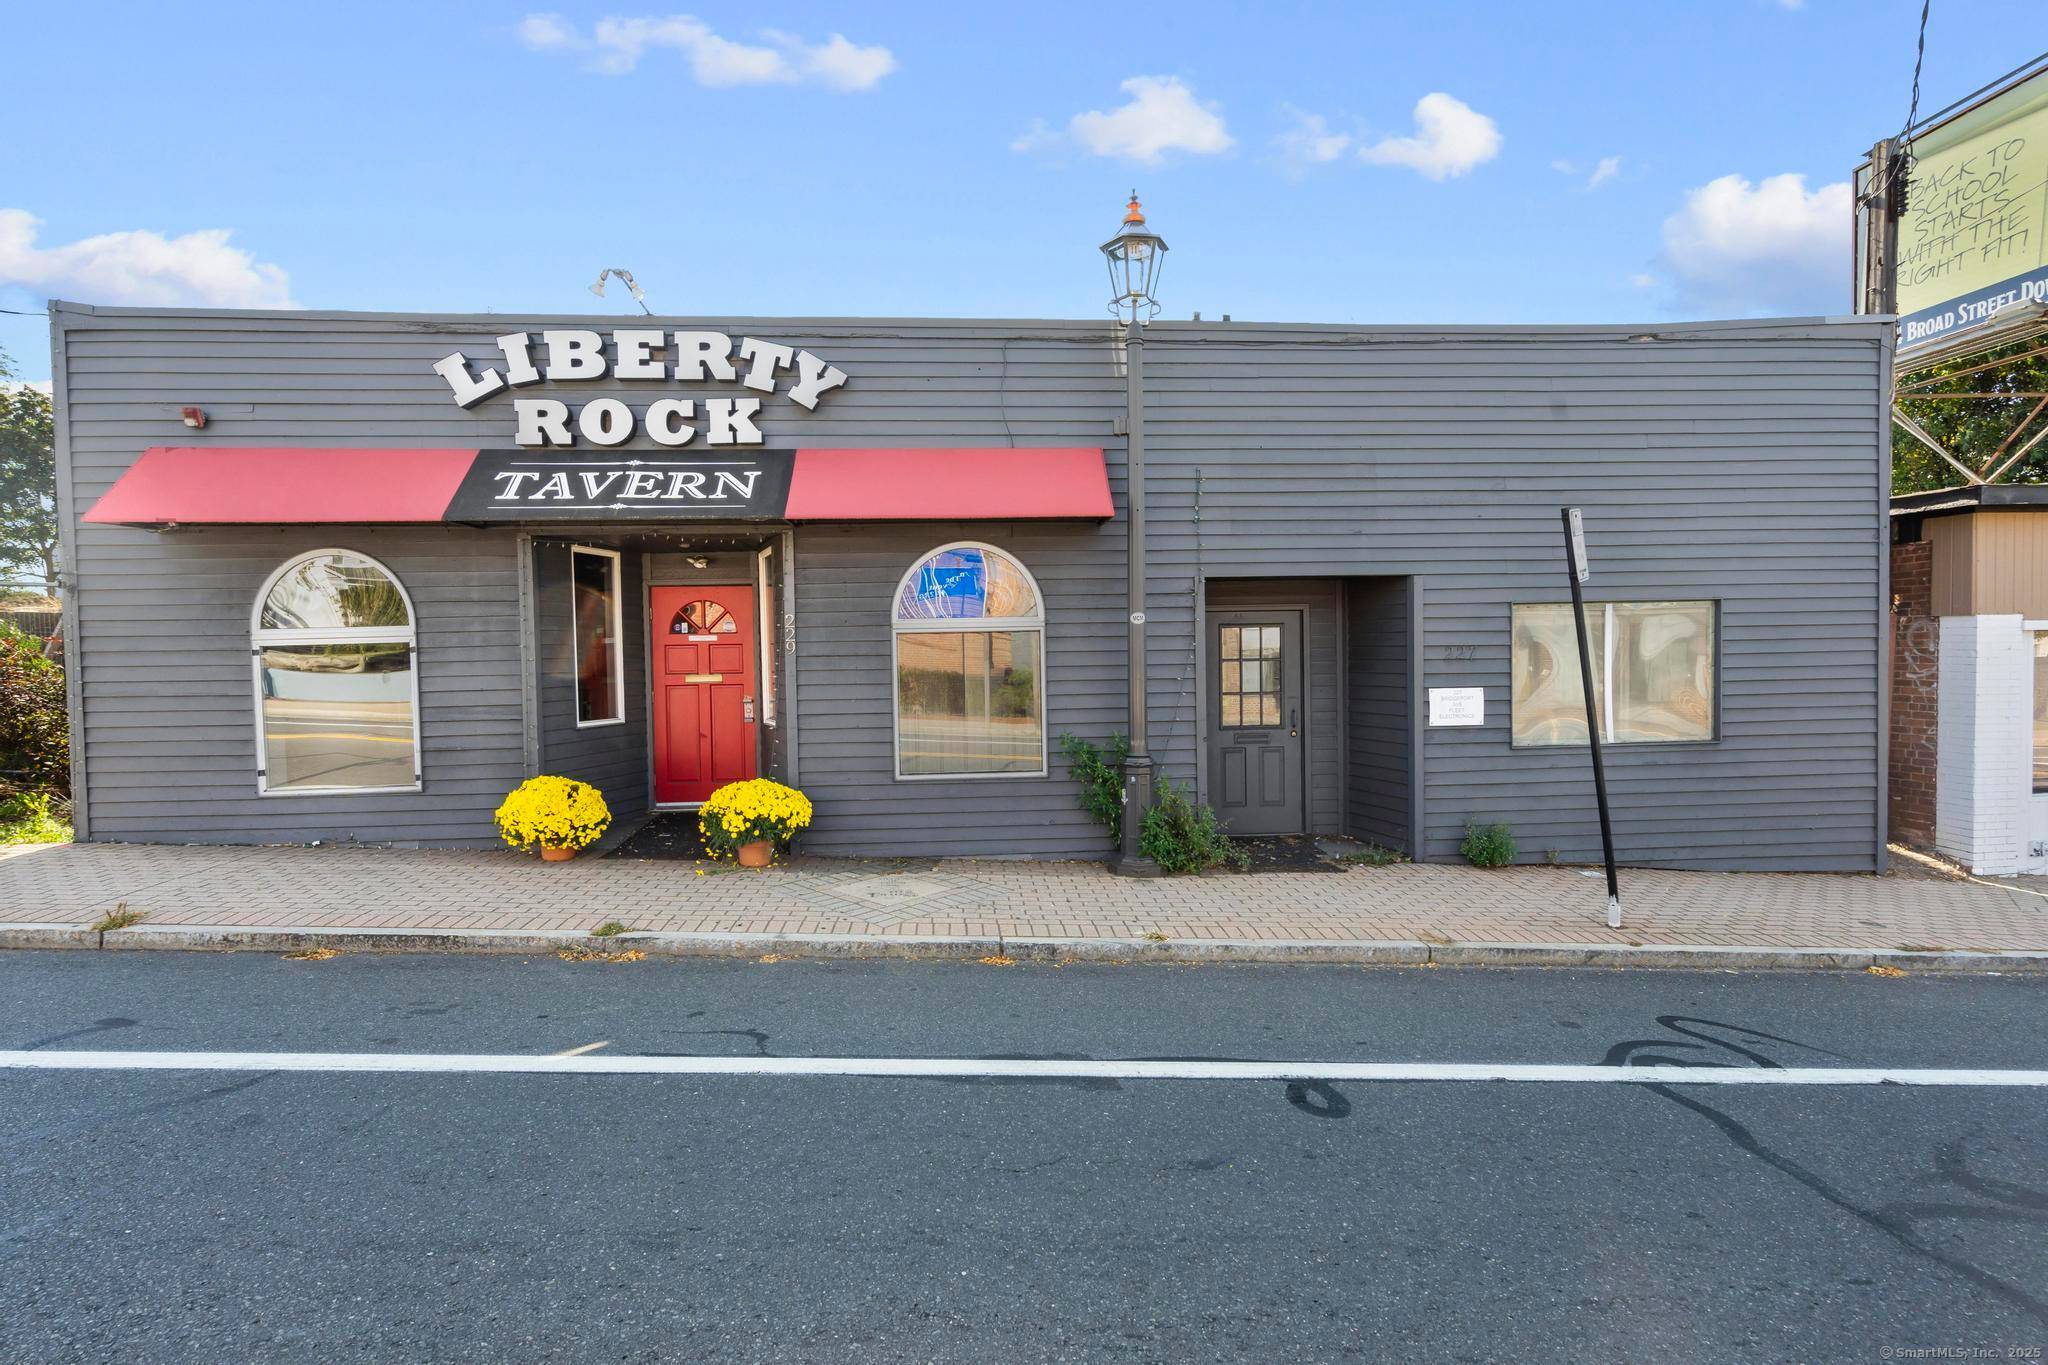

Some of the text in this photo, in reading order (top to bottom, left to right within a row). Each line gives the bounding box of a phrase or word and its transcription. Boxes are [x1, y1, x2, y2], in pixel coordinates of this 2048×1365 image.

[1909, 138, 2026, 199] BACK TO
[1911, 165, 2019, 222] SCHOOL
[1899, 205, 2030, 268] WITH THE
[1914, 188, 2011, 242] STARTS
[1897, 228, 2029, 286] RIGHT FIT!
[1906, 312, 1955, 342] BROAD
[431, 328, 848, 411] LIBERTY
[514, 397, 764, 447] ROCK
[494, 470, 763, 501] TAVERN
[784, 614, 796, 655] 229
[1443, 645, 1476, 661] 227
